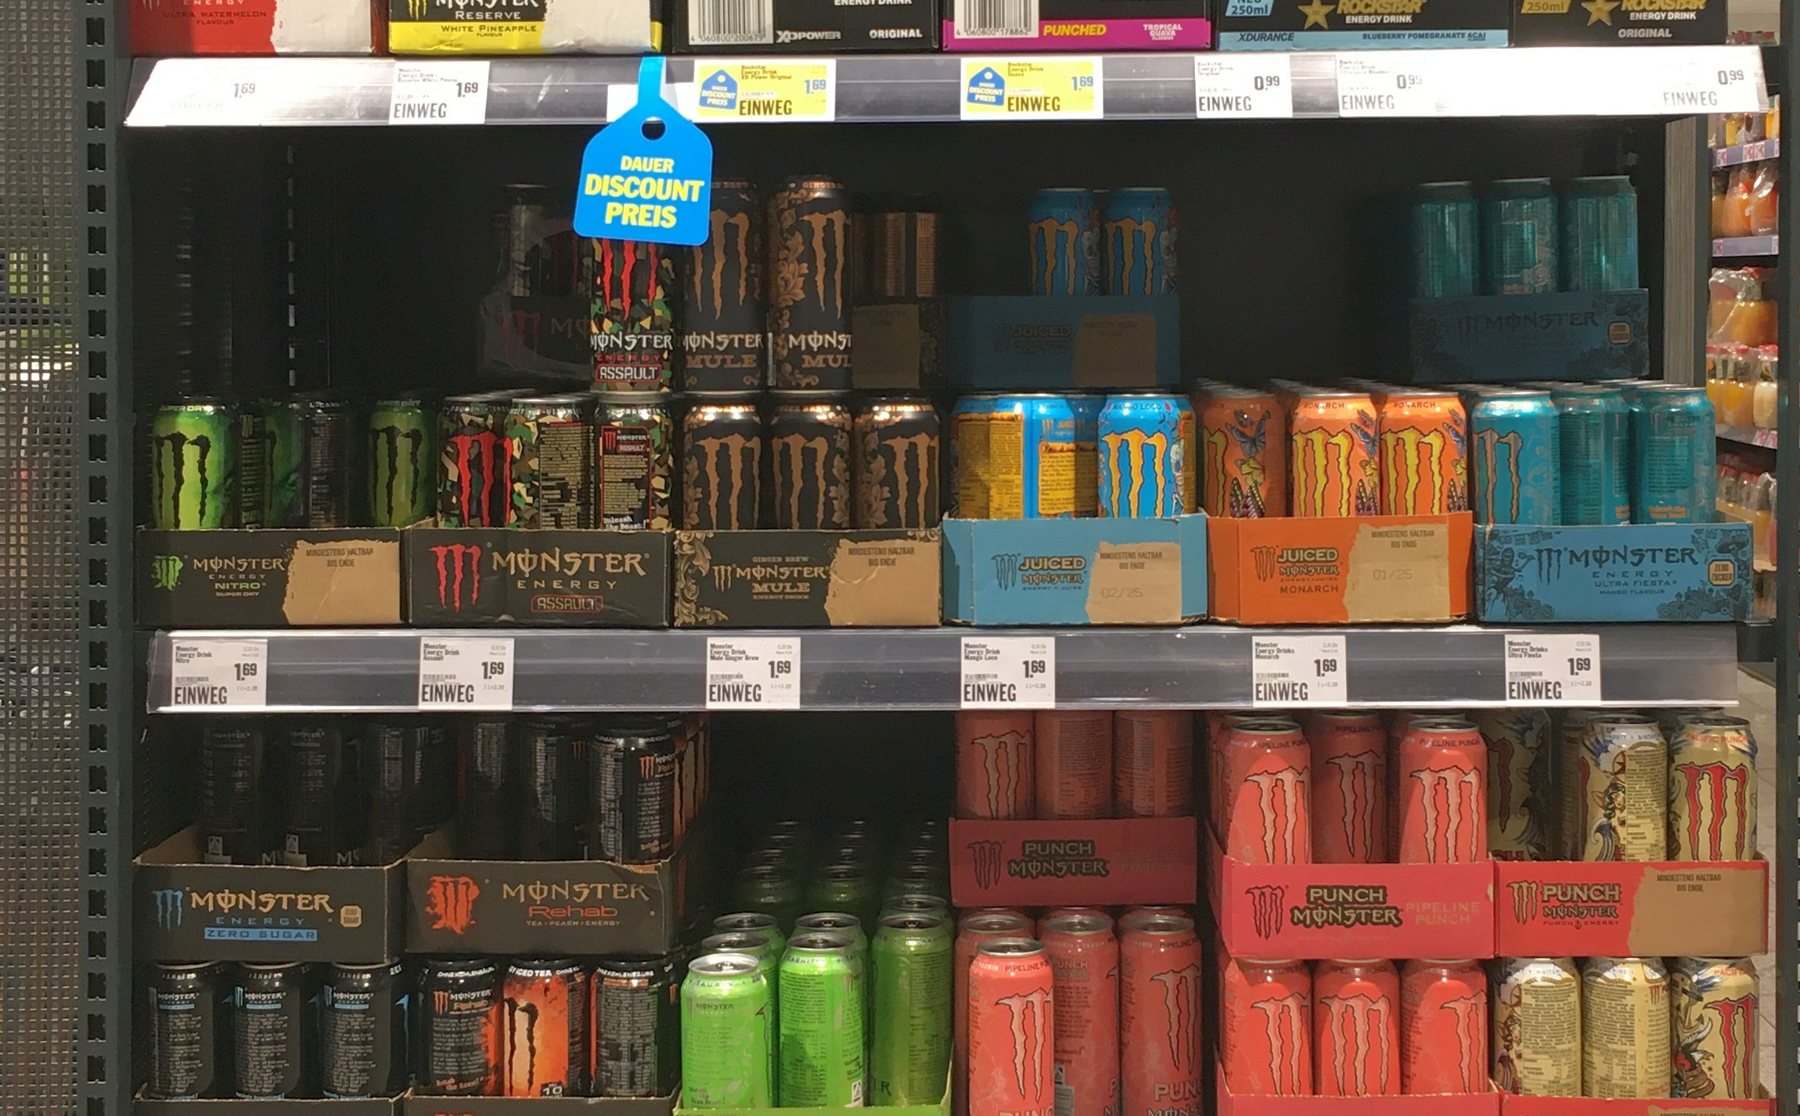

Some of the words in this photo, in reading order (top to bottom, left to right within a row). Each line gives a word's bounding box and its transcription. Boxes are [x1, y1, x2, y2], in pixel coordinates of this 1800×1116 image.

[1231, 5, 1268, 16] 250ml
[1337, 0, 1425, 13] ROCKSTAR
[1527, 1, 1564, 11] 250ml
[455, 11, 521, 20] RESERVE
[1346, 15, 1381, 24] ENERGY
[1383, 15, 1413, 23] DRINK
[1630, 12, 1665, 20] ENERGY
[1667, 12, 1697, 20] DRINK
[869, 30, 922, 39] ORIGINAL
[1043, 25, 1107, 36] PUNCHED
[1238, 33, 1294, 42] XDURANCE
[1618, 28, 1672, 38] ORIGINAL
[1072, 76, 1094, 91] 1.69
[1254, 76, 1280, 91] 0.99
[1396, 74, 1423, 89] 0.99
[1718, 70, 1744, 85] 0.99
[233, 83, 256, 98] 1.69
[456, 82, 479, 97] 1.69
[804, 80, 826, 95] 1.69
[1007, 96, 1061, 112] EINWEG
[1199, 96, 1252, 111] EINWEG
[1341, 95, 1395, 110] EINWEG
[1663, 91, 1718, 106] EINWEG
[394, 103, 447, 118] EINWEG
[739, 100, 792, 115] EINWEG
[620, 155, 675, 174] DAUER
[584, 173, 705, 202] DISCOUNT
[604, 202, 678, 228] PREIS
[590, 331, 674, 351] MONSTER
[686, 355, 757, 368] MULE
[599, 366, 658, 380] ASSAULT
[491, 547, 647, 577] MONSTER
[1020, 556, 1086, 570] JUICED
[1278, 548, 1338, 563] JUICED
[1569, 544, 1699, 568] MONSTER
[193, 556, 286, 571] MONSTER
[1280, 564, 1340, 576] MONSTER
[736, 564, 827, 580] MONSTER
[1022, 572, 1084, 585] MONSTER
[1373, 568, 1413, 580] 01/25
[1592, 570, 1673, 578] ENERGY
[215, 582, 261, 590] NITRO
[517, 579, 618, 589] ENERGY
[751, 582, 811, 593] MULE
[1280, 585, 1339, 594] MONARCH
[537, 597, 595, 610] ASSAULT
[234, 662, 257, 680] 1.69
[481, 661, 504, 679] 1.69
[768, 660, 791, 678] 1.69
[1022, 660, 1046, 678] 1.69
[1314, 658, 1337, 677] 1.69
[1567, 657, 1591, 675] 1.69
[174, 686, 228, 704] EINWEG
[421, 684, 475, 702] EINWEG
[709, 684, 762, 702] EINWEG
[963, 683, 1017, 701] EINWEG
[1255, 682, 1308, 700] EINWEG
[1508, 681, 1562, 699] EINWEG
[1024, 842, 1092, 855] PUNCH
[1009, 858, 1107, 877] MONSTER
[1656, 874, 1694, 882] MINDESTENS
[1695, 874, 1722, 882] HALTBAR
[502, 880, 650, 904] MONSTER
[1309, 888, 1384, 901] PUNCH
[1542, 883, 1620, 901] PUNCH
[1676, 884, 1687, 892] BIS
[190, 889, 335, 913] MONSTER
[1405, 901, 1480, 913] PIPELINE
[528, 905, 619, 918] Rehab
[1293, 903, 1400, 926] MONSTER
[1542, 904, 1619, 920] MONSTER
[216, 916, 305, 925] ENERGY
[1415, 914, 1470, 925] PUNCH
[207, 929, 250, 938] ZERO
[259, 930, 316, 939] SUGAR
[450, 989, 492, 1000] MONSTER
